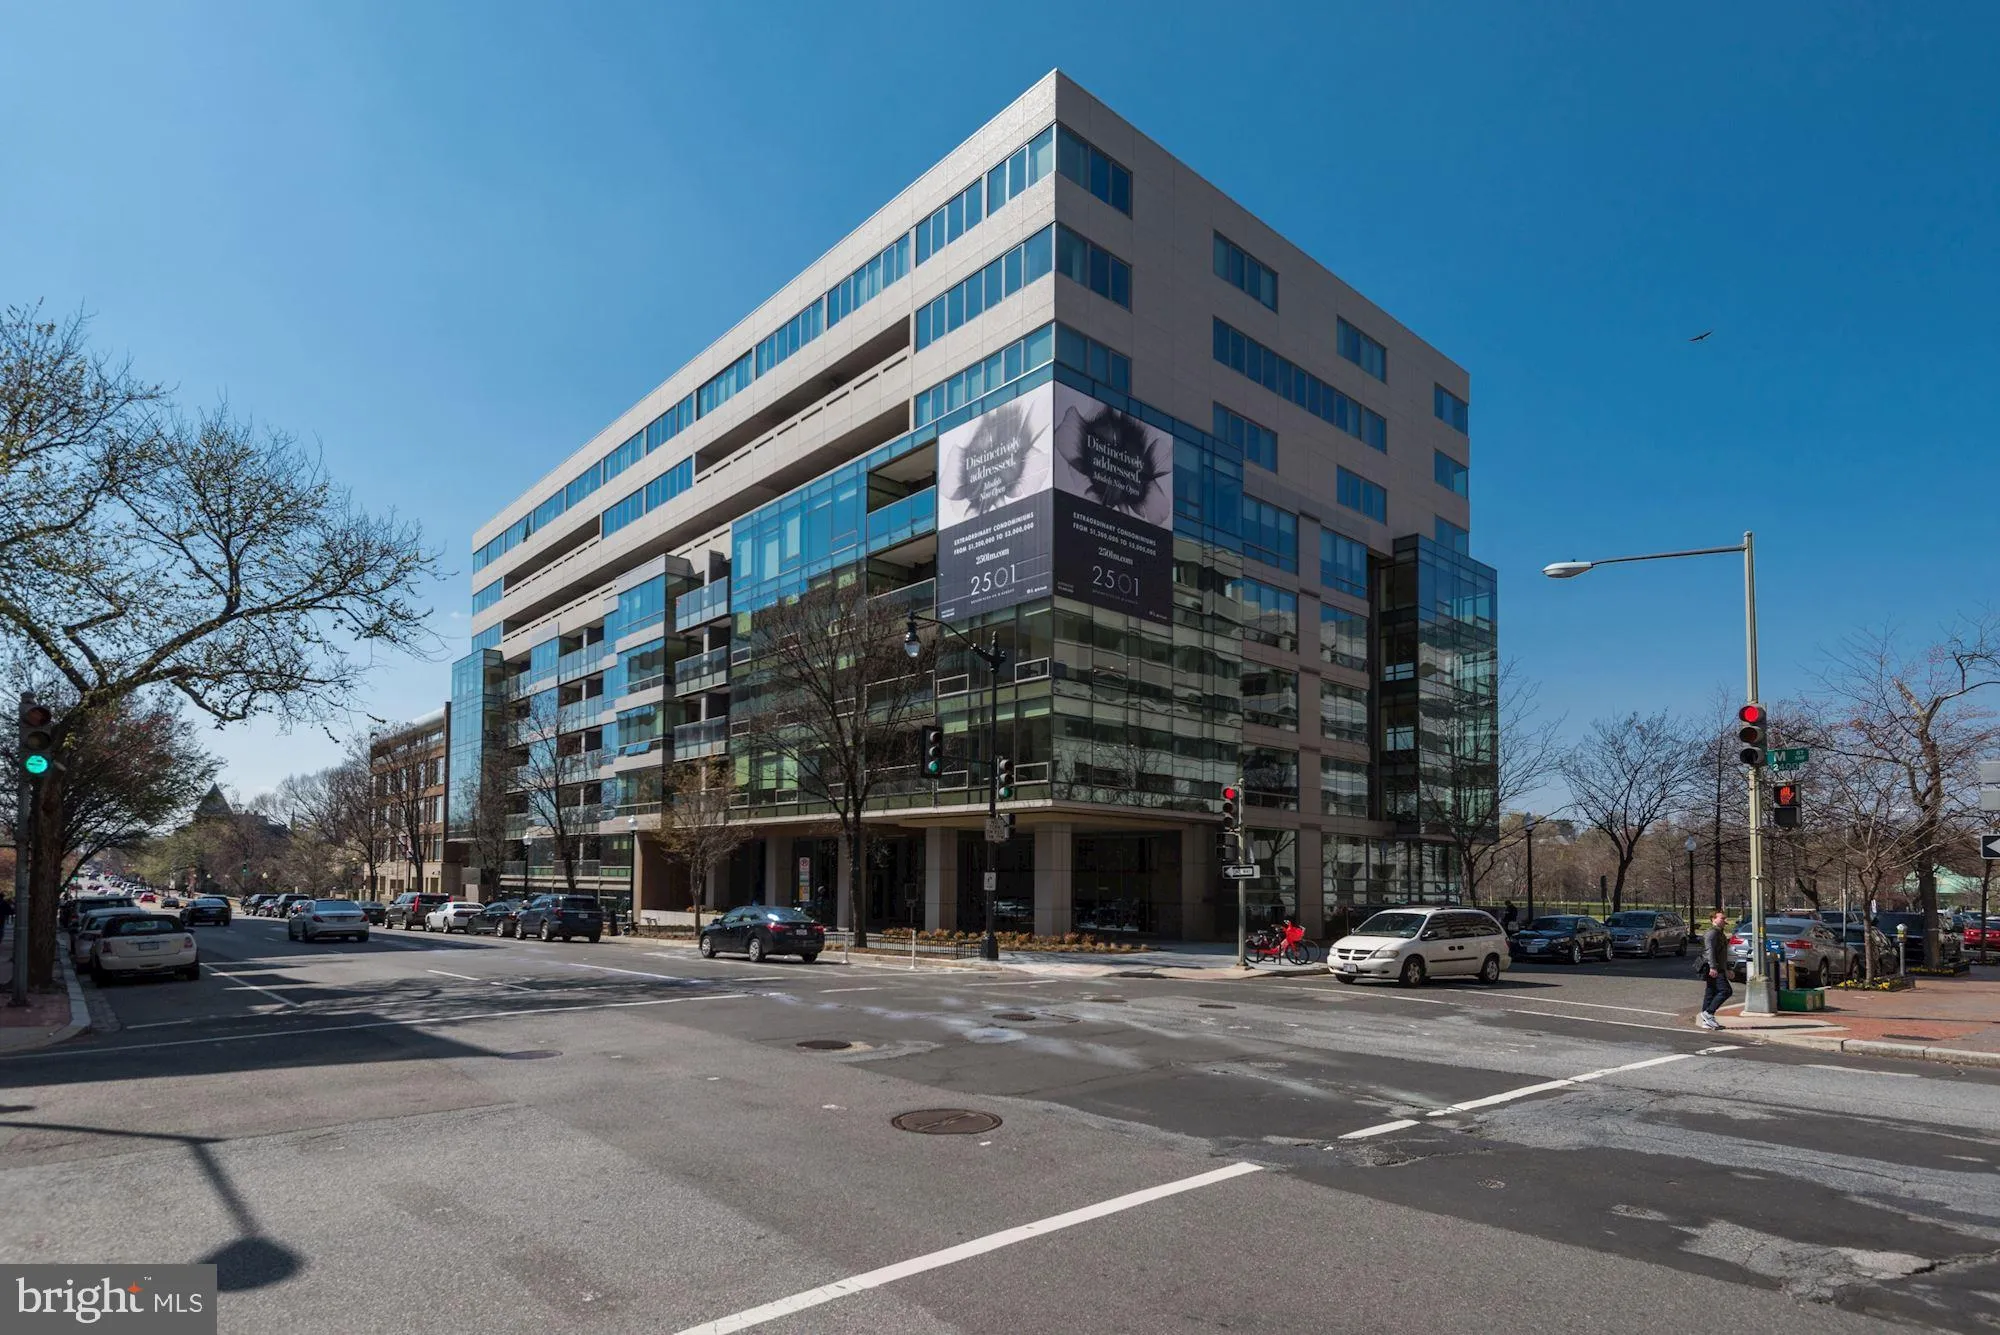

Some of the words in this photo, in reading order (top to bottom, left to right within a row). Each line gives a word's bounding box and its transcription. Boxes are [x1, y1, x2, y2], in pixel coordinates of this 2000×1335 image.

[966, 436, 1021, 470] Distinctively
[1087, 435, 1145, 471] Distinctively
[969, 454, 1017, 483] addressed.
[1093, 456, 1141, 483] addressed.
[1126, 484, 1140, 496] Open
[954, 527, 992, 546] EXTRAORDINARY
[993, 512, 1034, 532] CONDOMINIUMS
[1073, 511, 1116, 532] EXTRAORDINARY
[1116, 528, 1156, 546] CONDOMINIUMS
[1073, 522, 1089, 533] FROM
[1120, 538, 1128, 546] TO
[953, 545, 967, 555] FROM
[996, 533, 1003, 541] TO
[975, 548, 1010, 565] 2501m.com
[971, 563, 1015, 596] 2501
[1092, 565, 1139, 597] 2501
[1773, 751, 1786, 761] M
